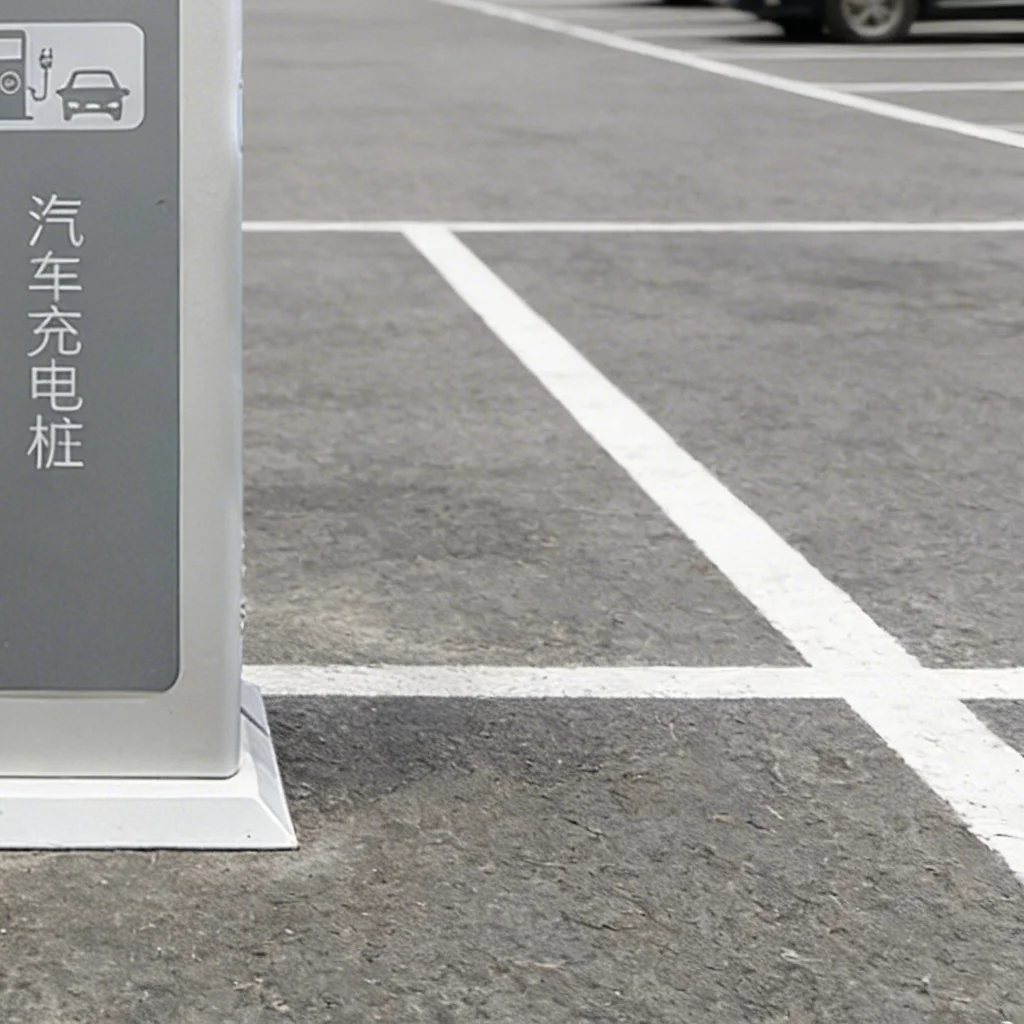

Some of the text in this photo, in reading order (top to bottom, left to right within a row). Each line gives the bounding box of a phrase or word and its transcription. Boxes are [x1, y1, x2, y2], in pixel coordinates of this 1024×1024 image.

[27, 193, 84, 470] 汽车充电桩
